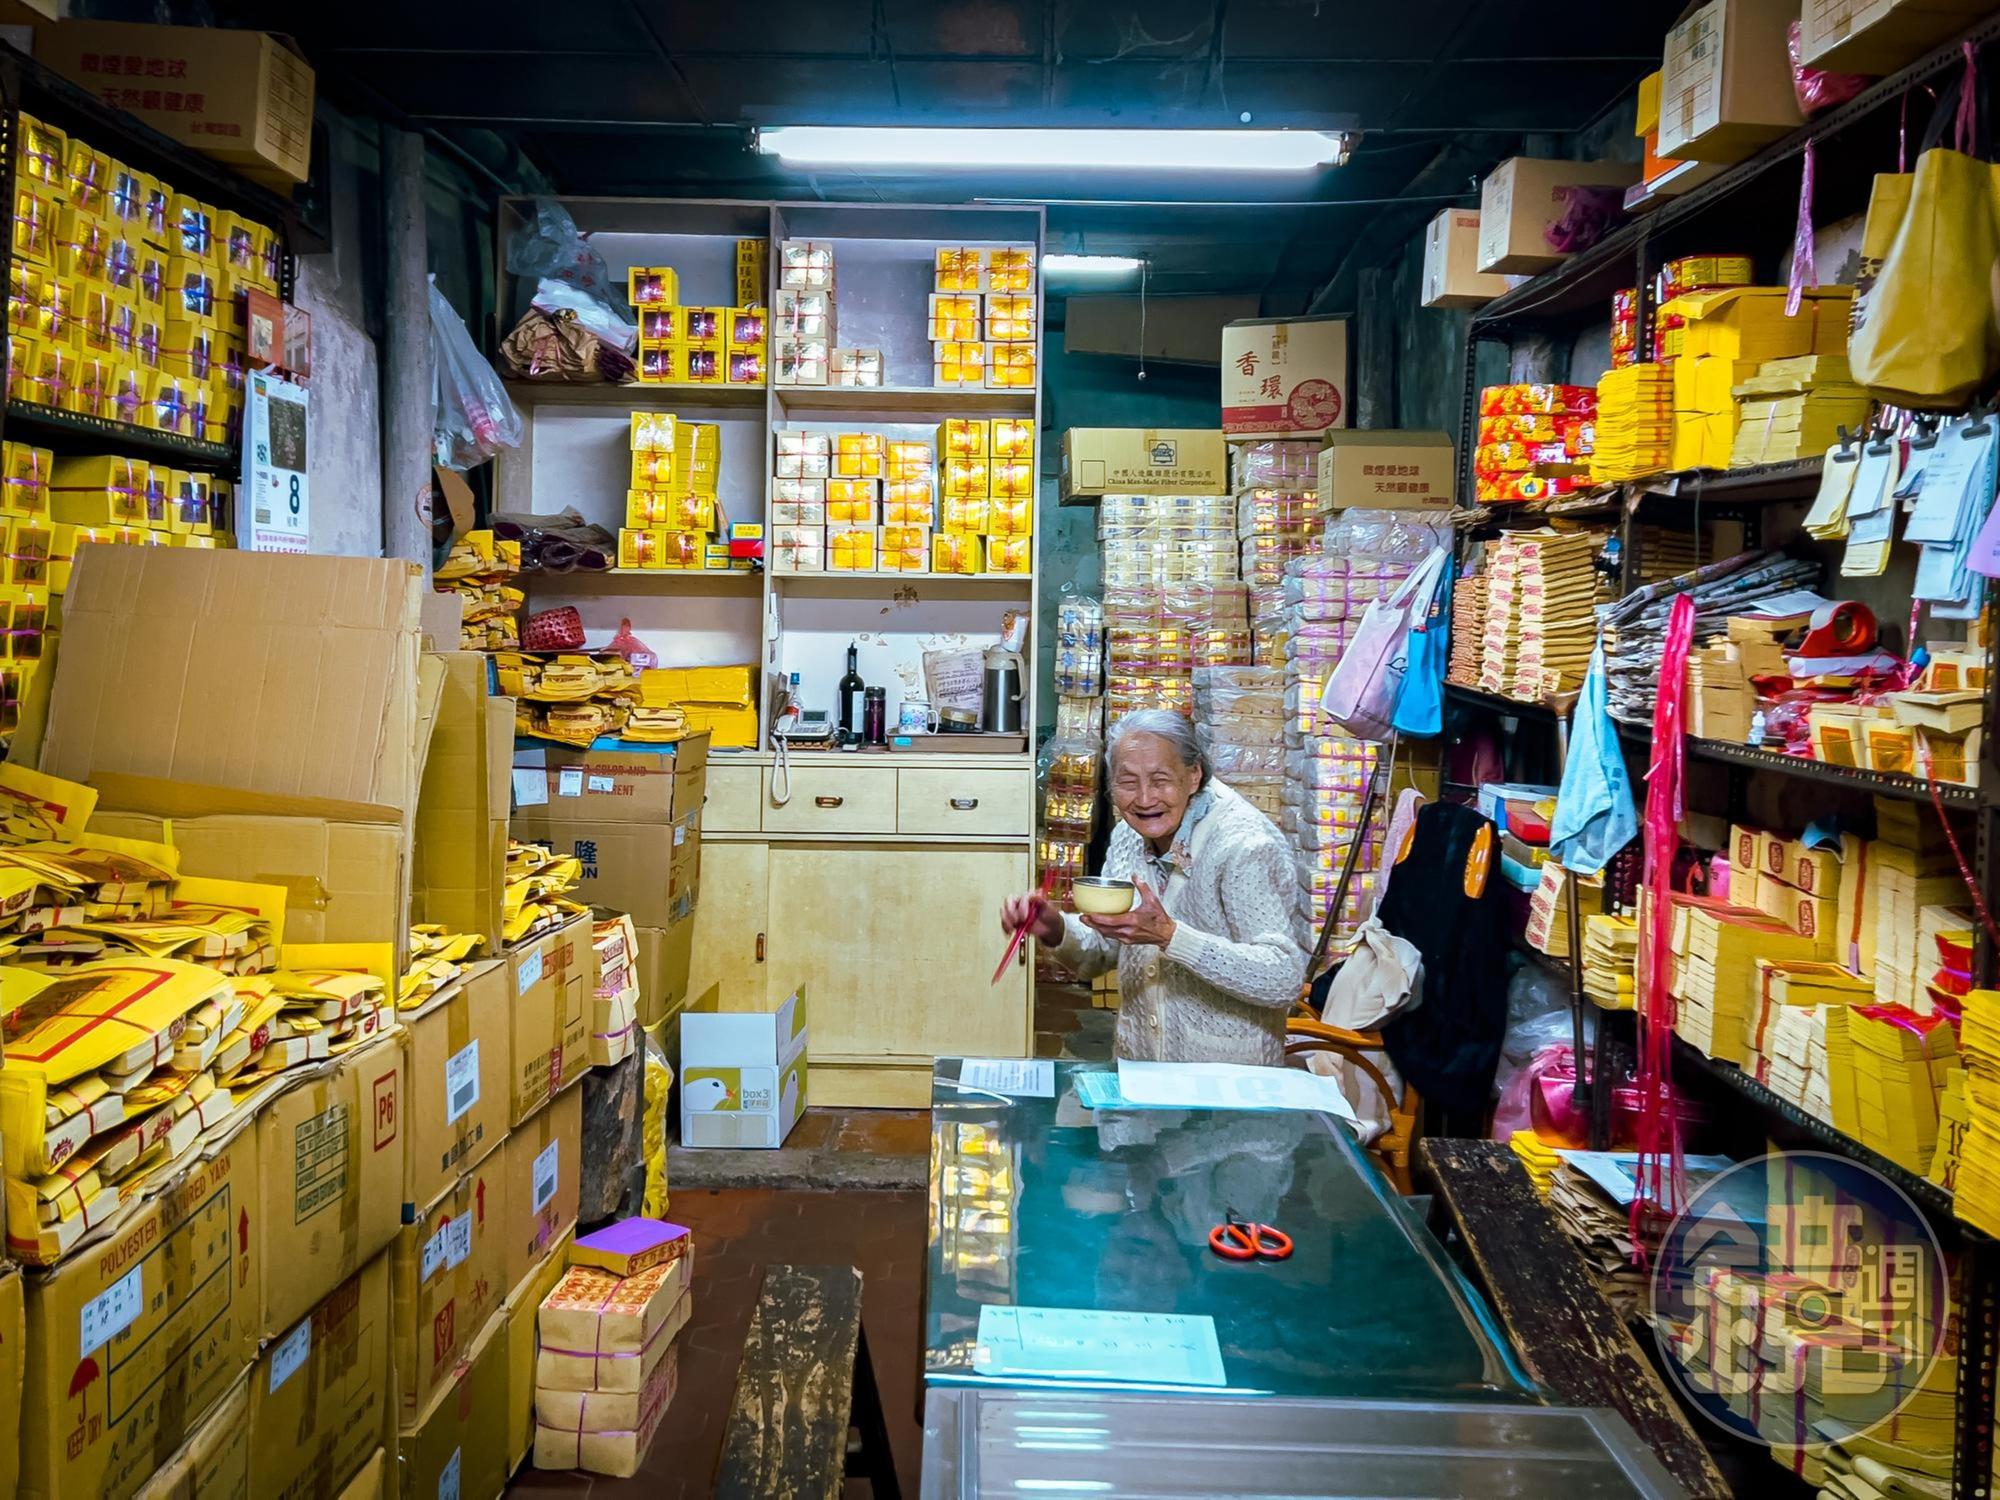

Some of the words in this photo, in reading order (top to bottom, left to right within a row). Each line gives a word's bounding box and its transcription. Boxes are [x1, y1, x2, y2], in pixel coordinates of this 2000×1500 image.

[289, 474, 300, 515] 8
[378, 1090, 394, 1131] P6
[742, 1088, 769, 1099] box3
[100, 1217, 158, 1281] POLYESTER
[209, 1153, 231, 1186] YARN
